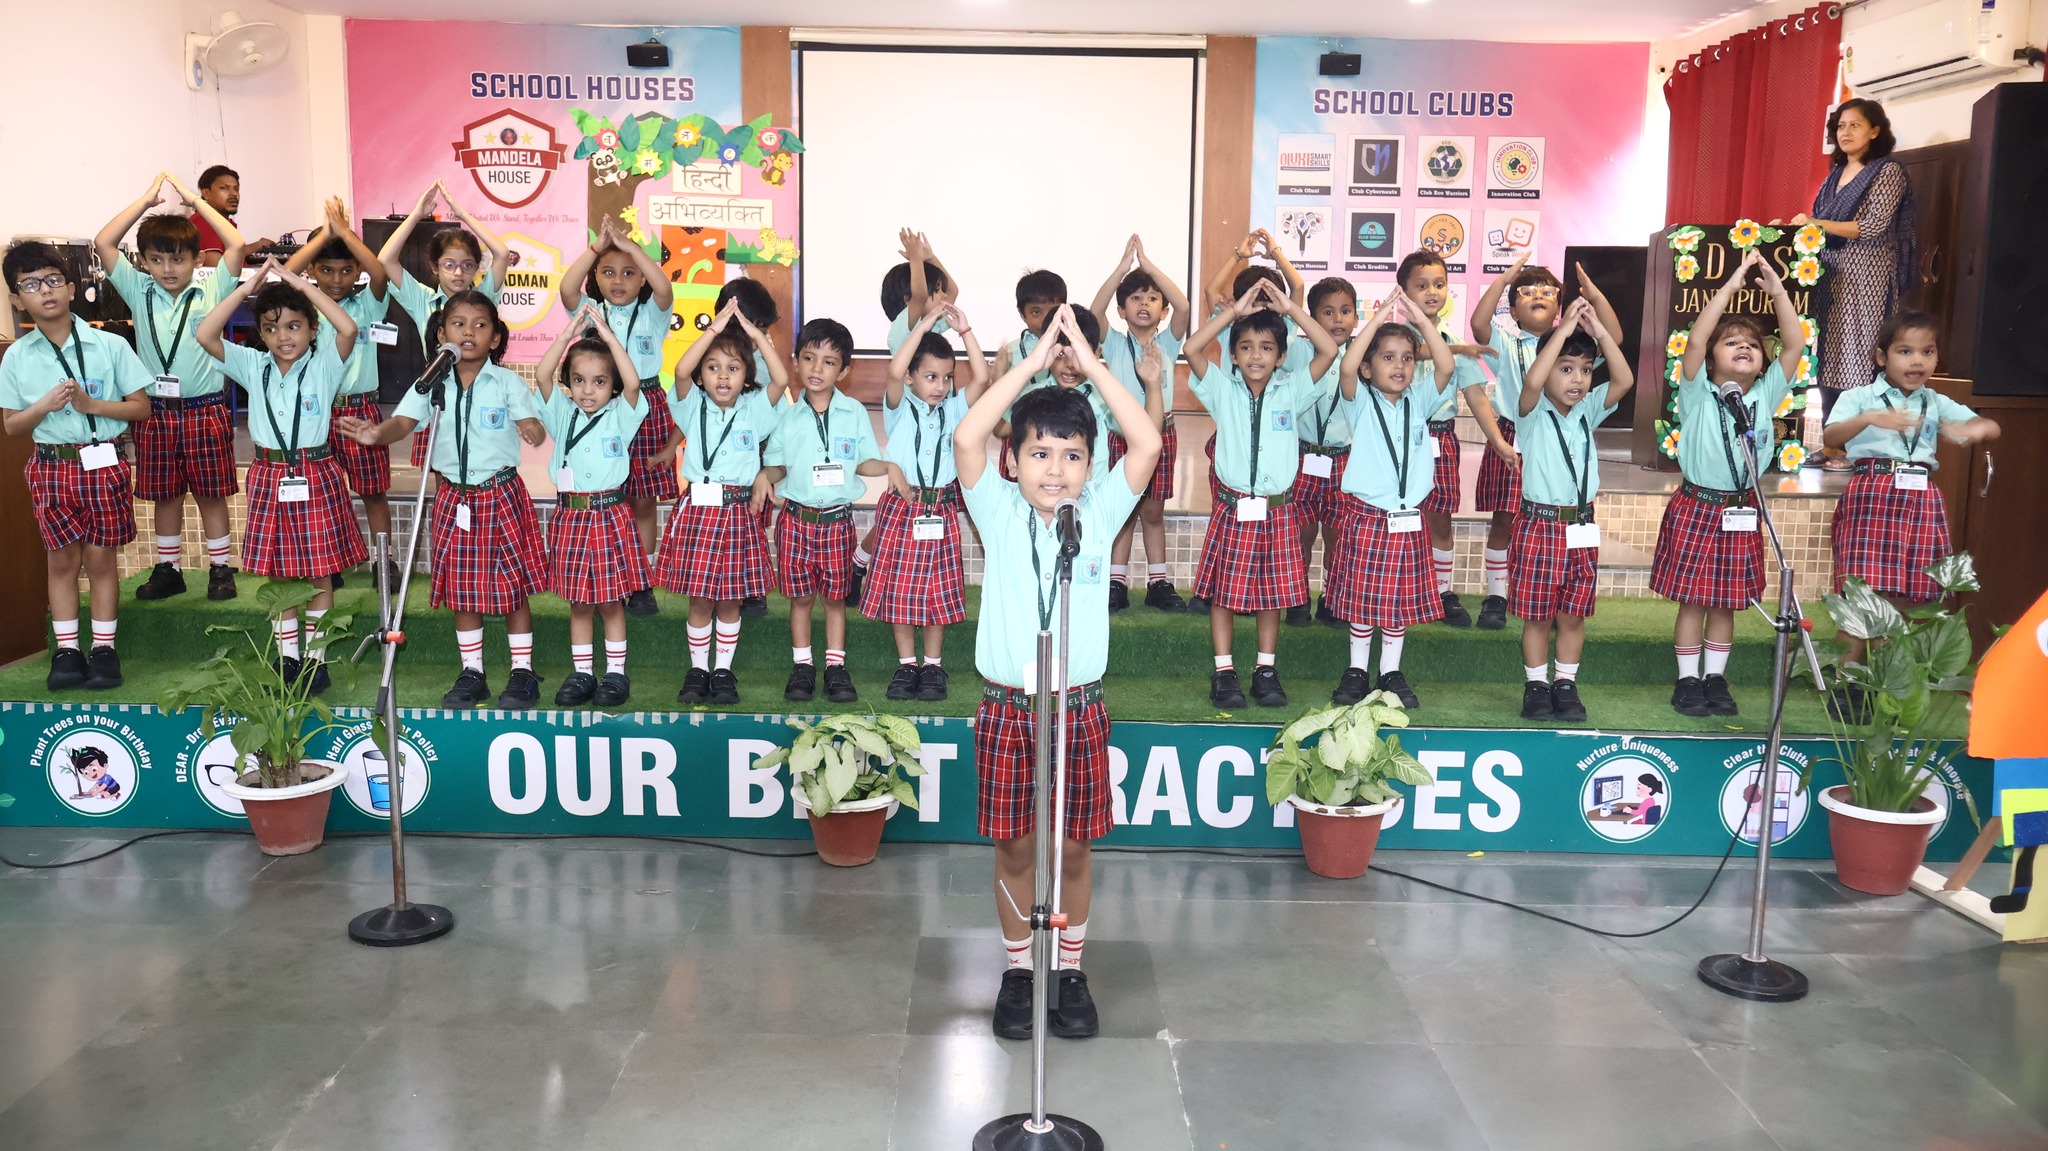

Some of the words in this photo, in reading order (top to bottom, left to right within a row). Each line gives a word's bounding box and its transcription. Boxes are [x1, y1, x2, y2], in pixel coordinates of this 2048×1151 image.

[471, 72, 578, 100] SCHOOL
[587, 75, 694, 101] HOUSES
[1313, 88, 1420, 116] SCHOOL
[1428, 91, 1514, 117] CLUBS
[477, 151, 542, 166] MANDELA
[488, 171, 532, 185] HOUSE
[682, 165, 732, 193] हिन्दी
[1704, 243, 1725, 280] D
[1773, 245, 1793, 282] S
[499, 292, 535, 306] OUSE
[1674, 288, 1810, 315] JANIPURM
[983, 686, 1001, 699] ELHI
[29, 737, 49, 767] Plant
[43, 717, 74, 738] Trees
[75, 714, 90, 724] on
[93, 715, 120, 730] your
[120, 725, 153, 769] Birthday
[325, 736, 345, 761] Half
[342, 721, 373, 740] Glass
[411, 730, 439, 762] Policy
[175, 752, 189, 783] DEAR
[1576, 743, 1618, 772] Nurture
[1621, 740, 1680, 773] Uniqueness
[1723, 748, 1753, 769] Clear
[1779, 745, 1809, 768] Clutte
[487, 732, 682, 817] OUR
[728, 738, 958, 823] BT
